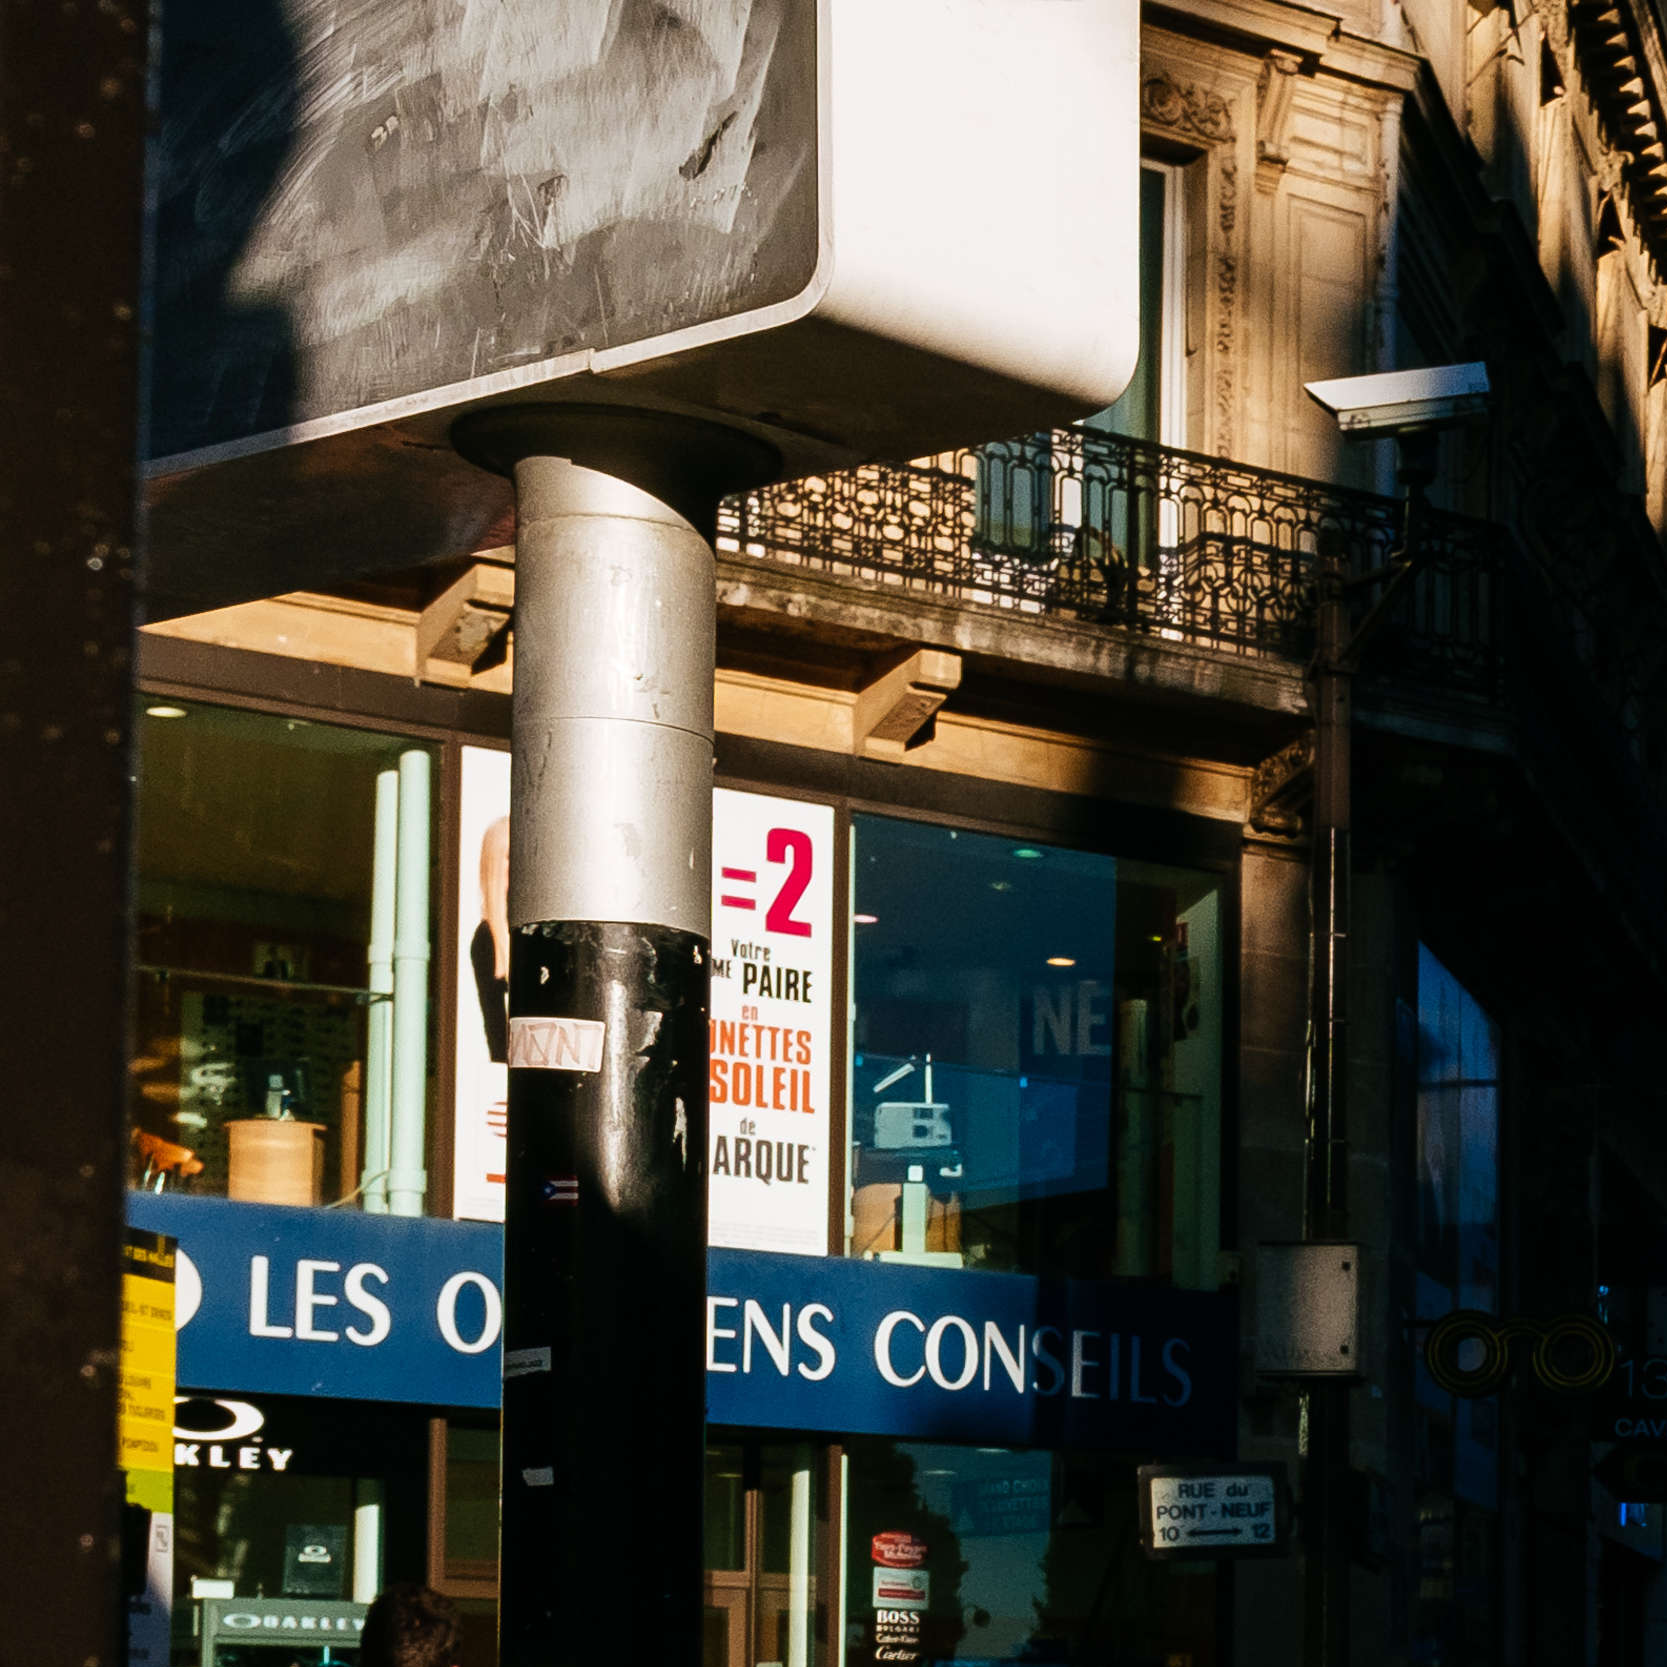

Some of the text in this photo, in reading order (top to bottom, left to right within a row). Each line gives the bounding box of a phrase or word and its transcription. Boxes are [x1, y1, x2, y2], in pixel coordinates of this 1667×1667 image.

[731, 939, 771, 961] Votre
[743, 962, 812, 1003] PAIRE
[742, 1005, 758, 1020] en
[709, 1018, 812, 1065] NETTES
[709, 1058, 815, 1114] SOLEIL
[740, 1117, 755, 1135] de
[712, 1135, 809, 1185] ARQUE
[250, 1255, 391, 1347] LES
[874, 1310, 1193, 1408] CONSEILS
[174, 1444, 293, 1471] KLEY
[1178, 1482, 1249, 1499] RUE du
[1160, 1523, 1271, 1541] 10 12
[262, 1614, 366, 1631] OAKLEY
[876, 1609, 920, 1624] BOSS
